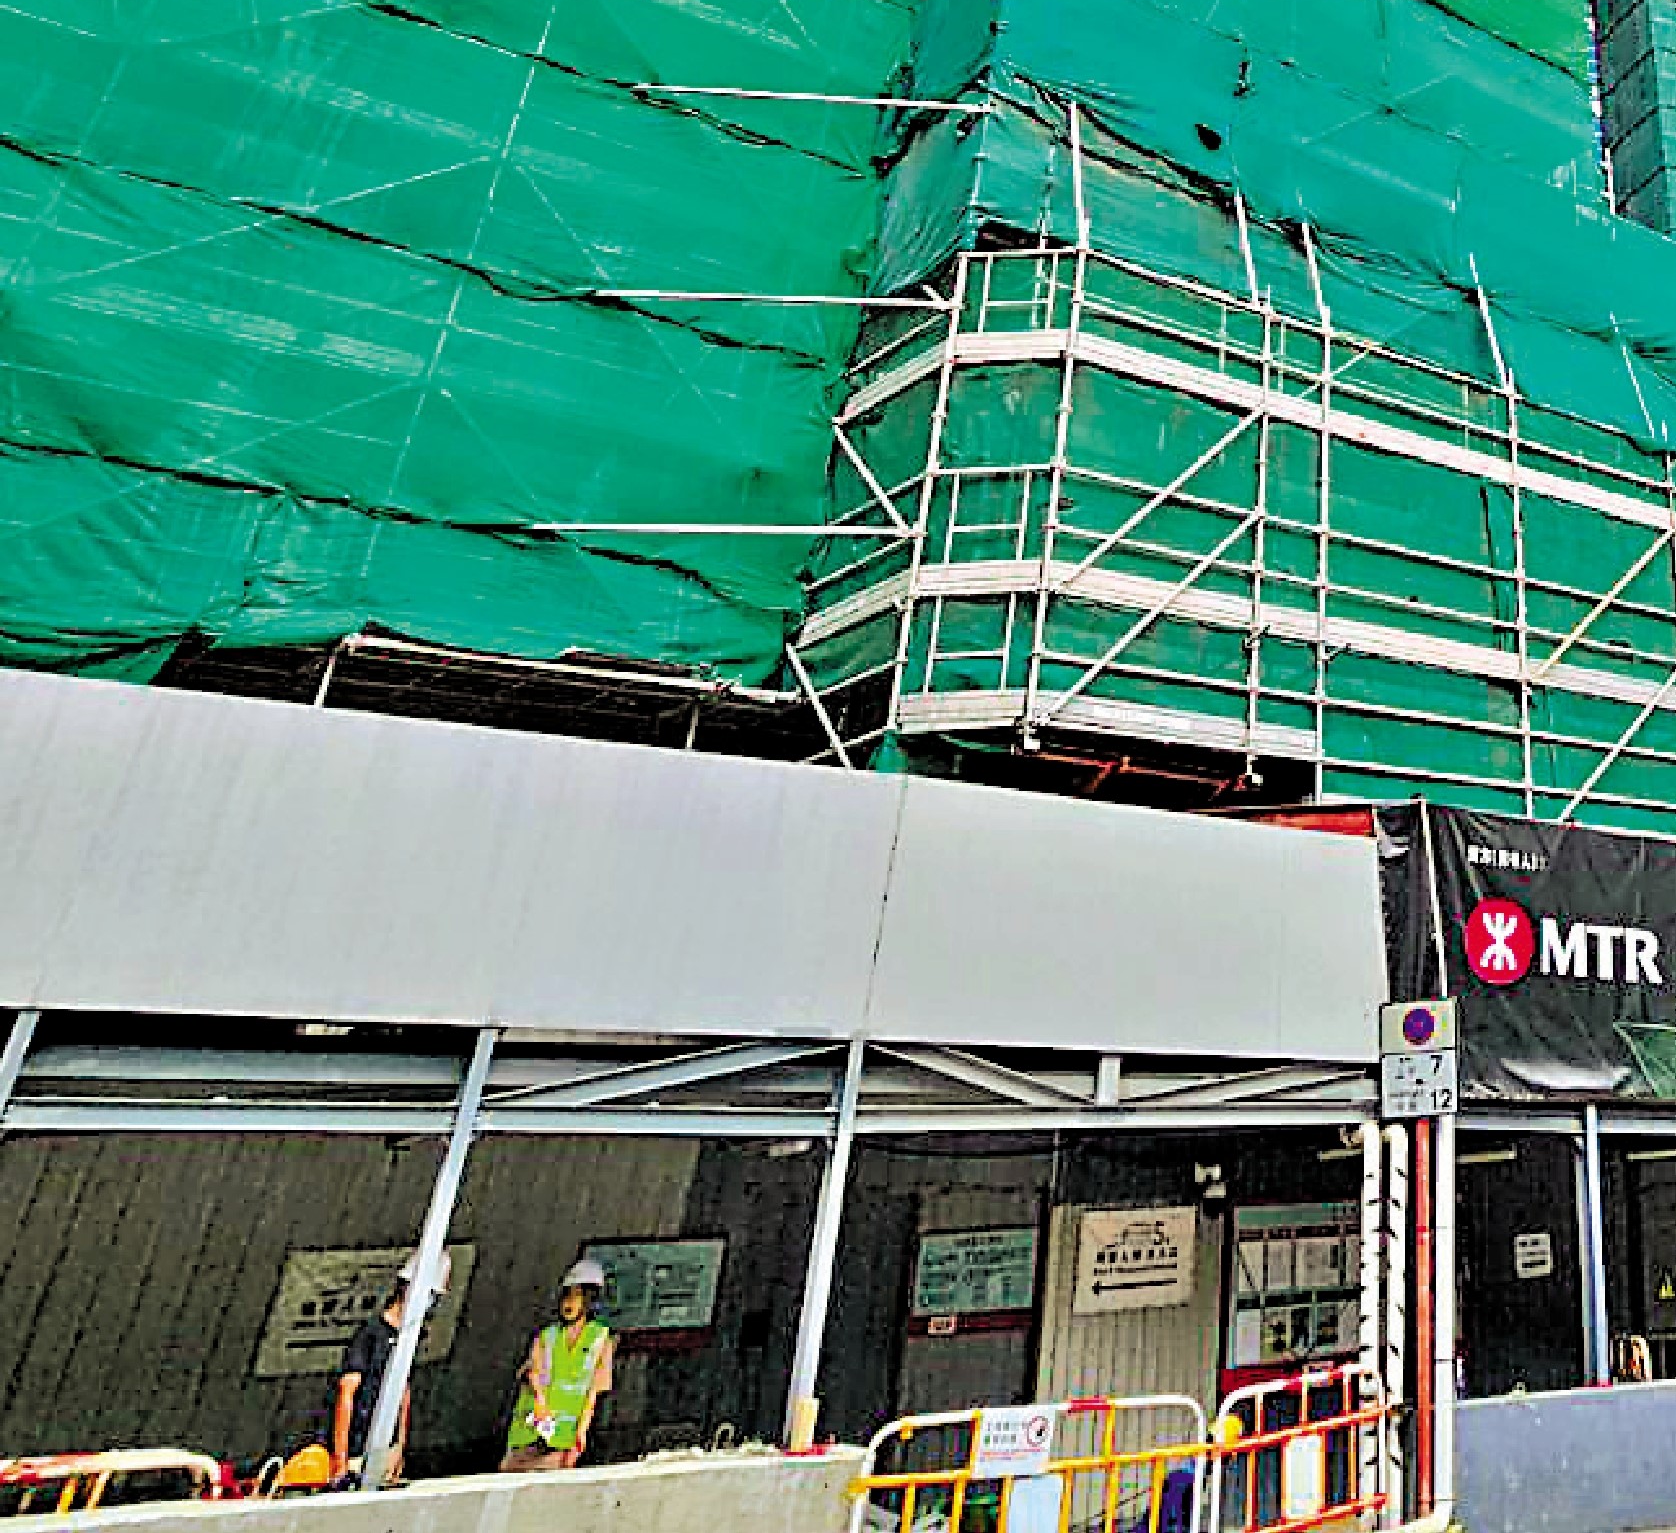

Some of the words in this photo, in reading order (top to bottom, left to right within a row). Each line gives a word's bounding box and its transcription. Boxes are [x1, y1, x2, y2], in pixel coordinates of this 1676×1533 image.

[1540, 916, 1663, 985] MTR
[1430, 1054, 1443, 1077] 7
[1430, 1088, 1453, 1111] 12
